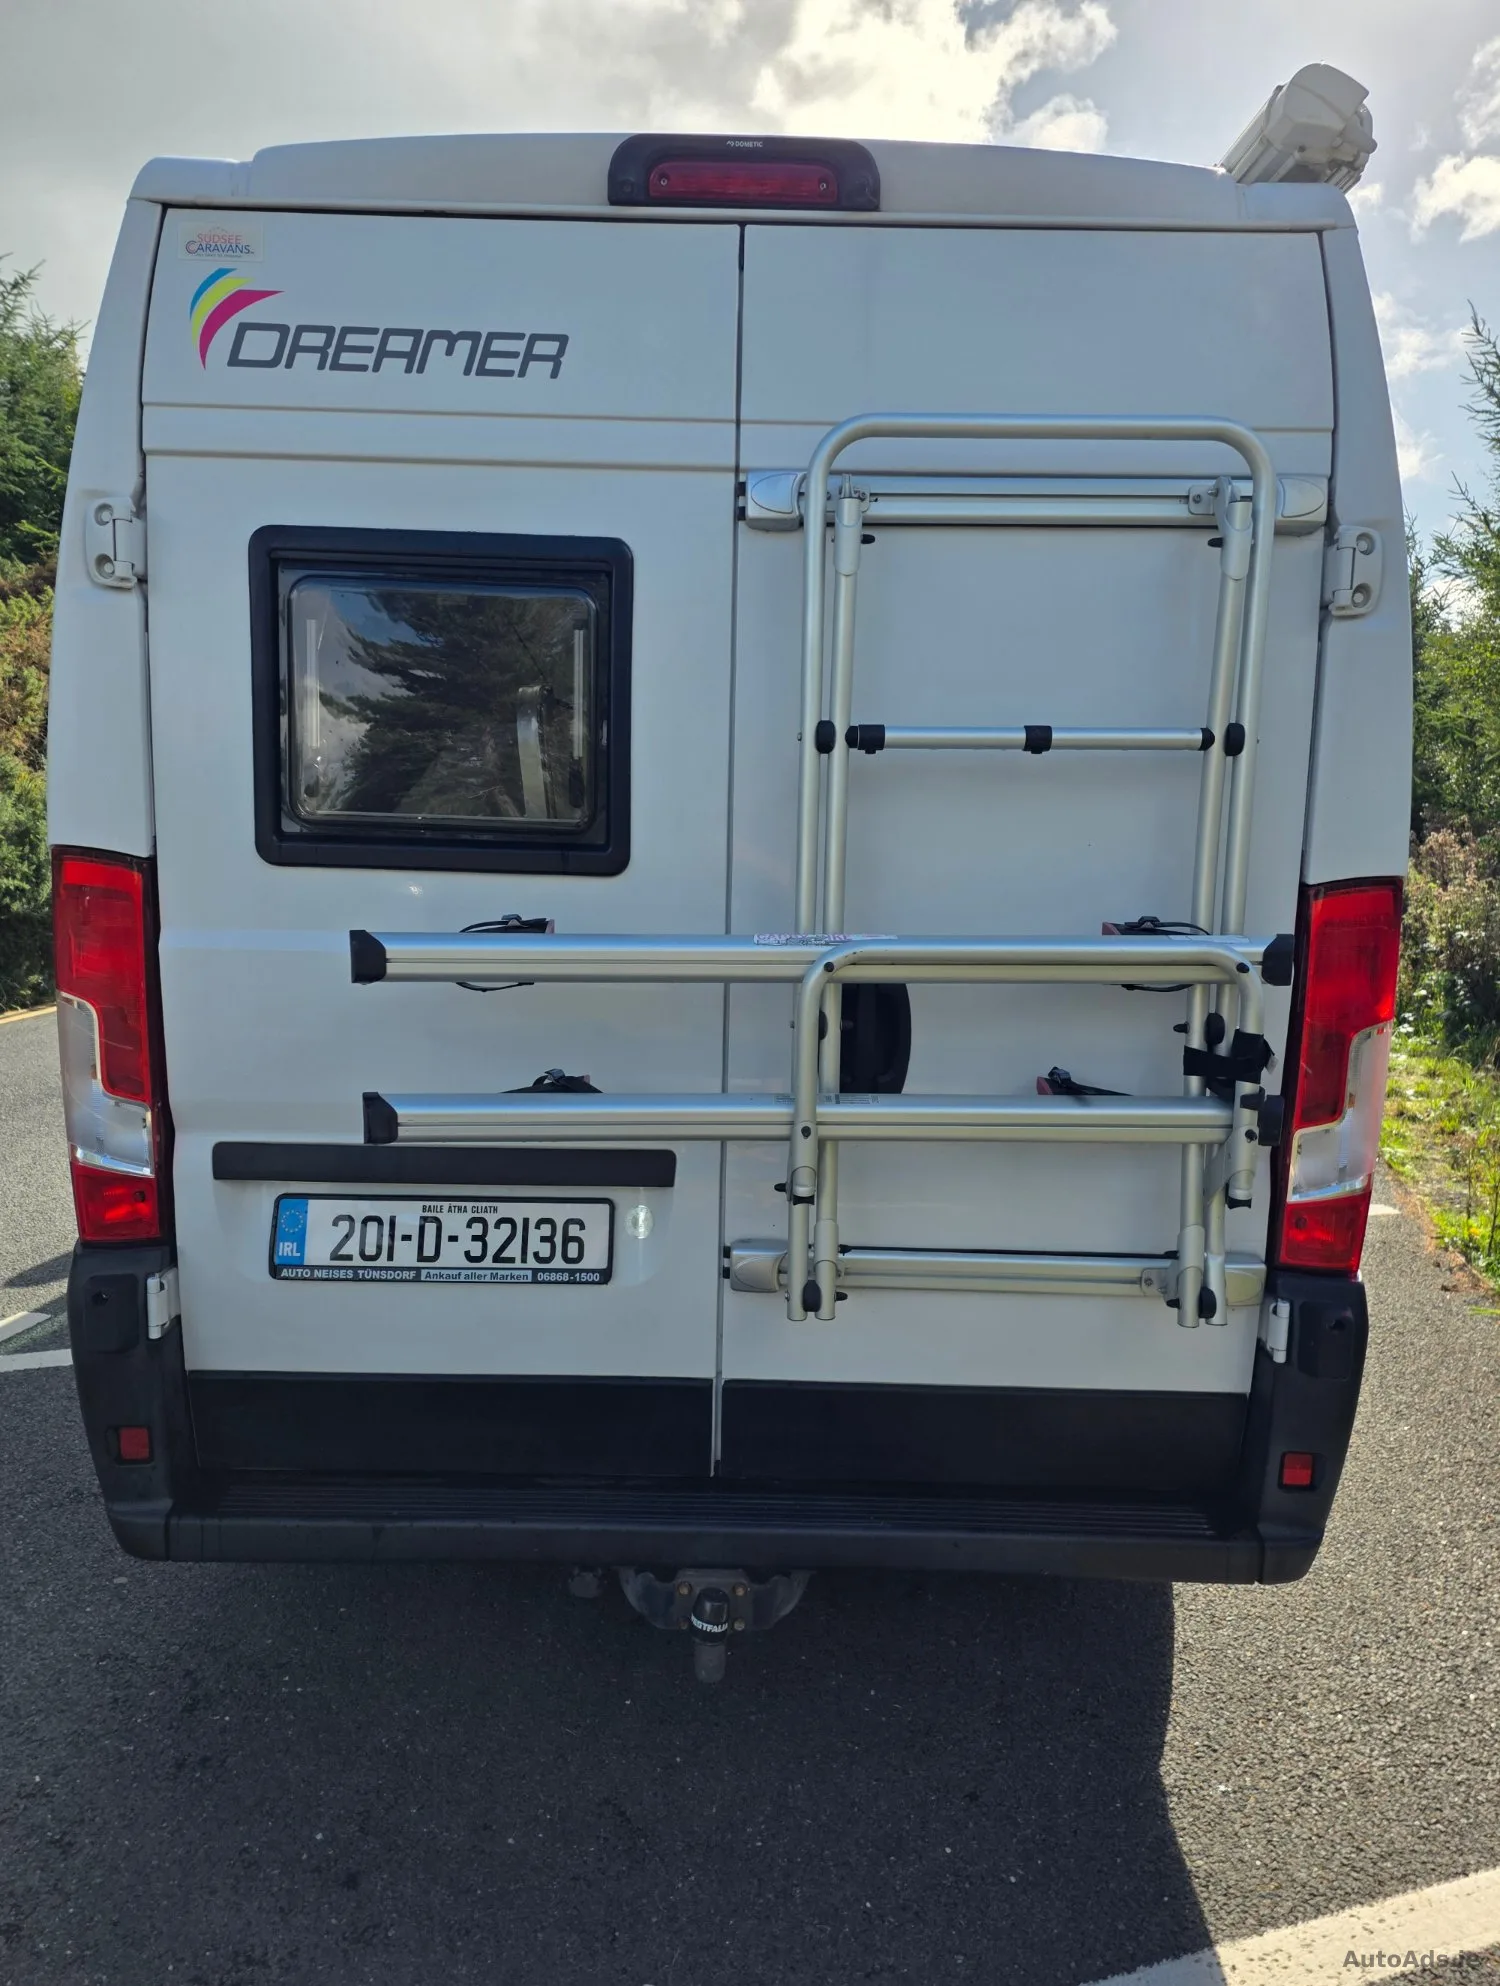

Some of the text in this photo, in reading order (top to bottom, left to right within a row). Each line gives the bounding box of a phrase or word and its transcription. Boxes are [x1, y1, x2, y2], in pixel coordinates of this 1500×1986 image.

[185, 240, 252, 255] CARAVANS
[226, 321, 570, 380] DREAMER
[421, 1204, 445, 1214] BAILE
[471, 1205, 499, 1214] CLIATH
[328, 1213, 587, 1265] 201-D-32136
[278, 1241, 301, 1257] IRL
[280, 1268, 417, 1280] AUTO NEISES TÜNSDORF
[424, 1270, 529, 1281] Ankauf aller Marken
[536, 1271, 601, 1282] 06868-1500
